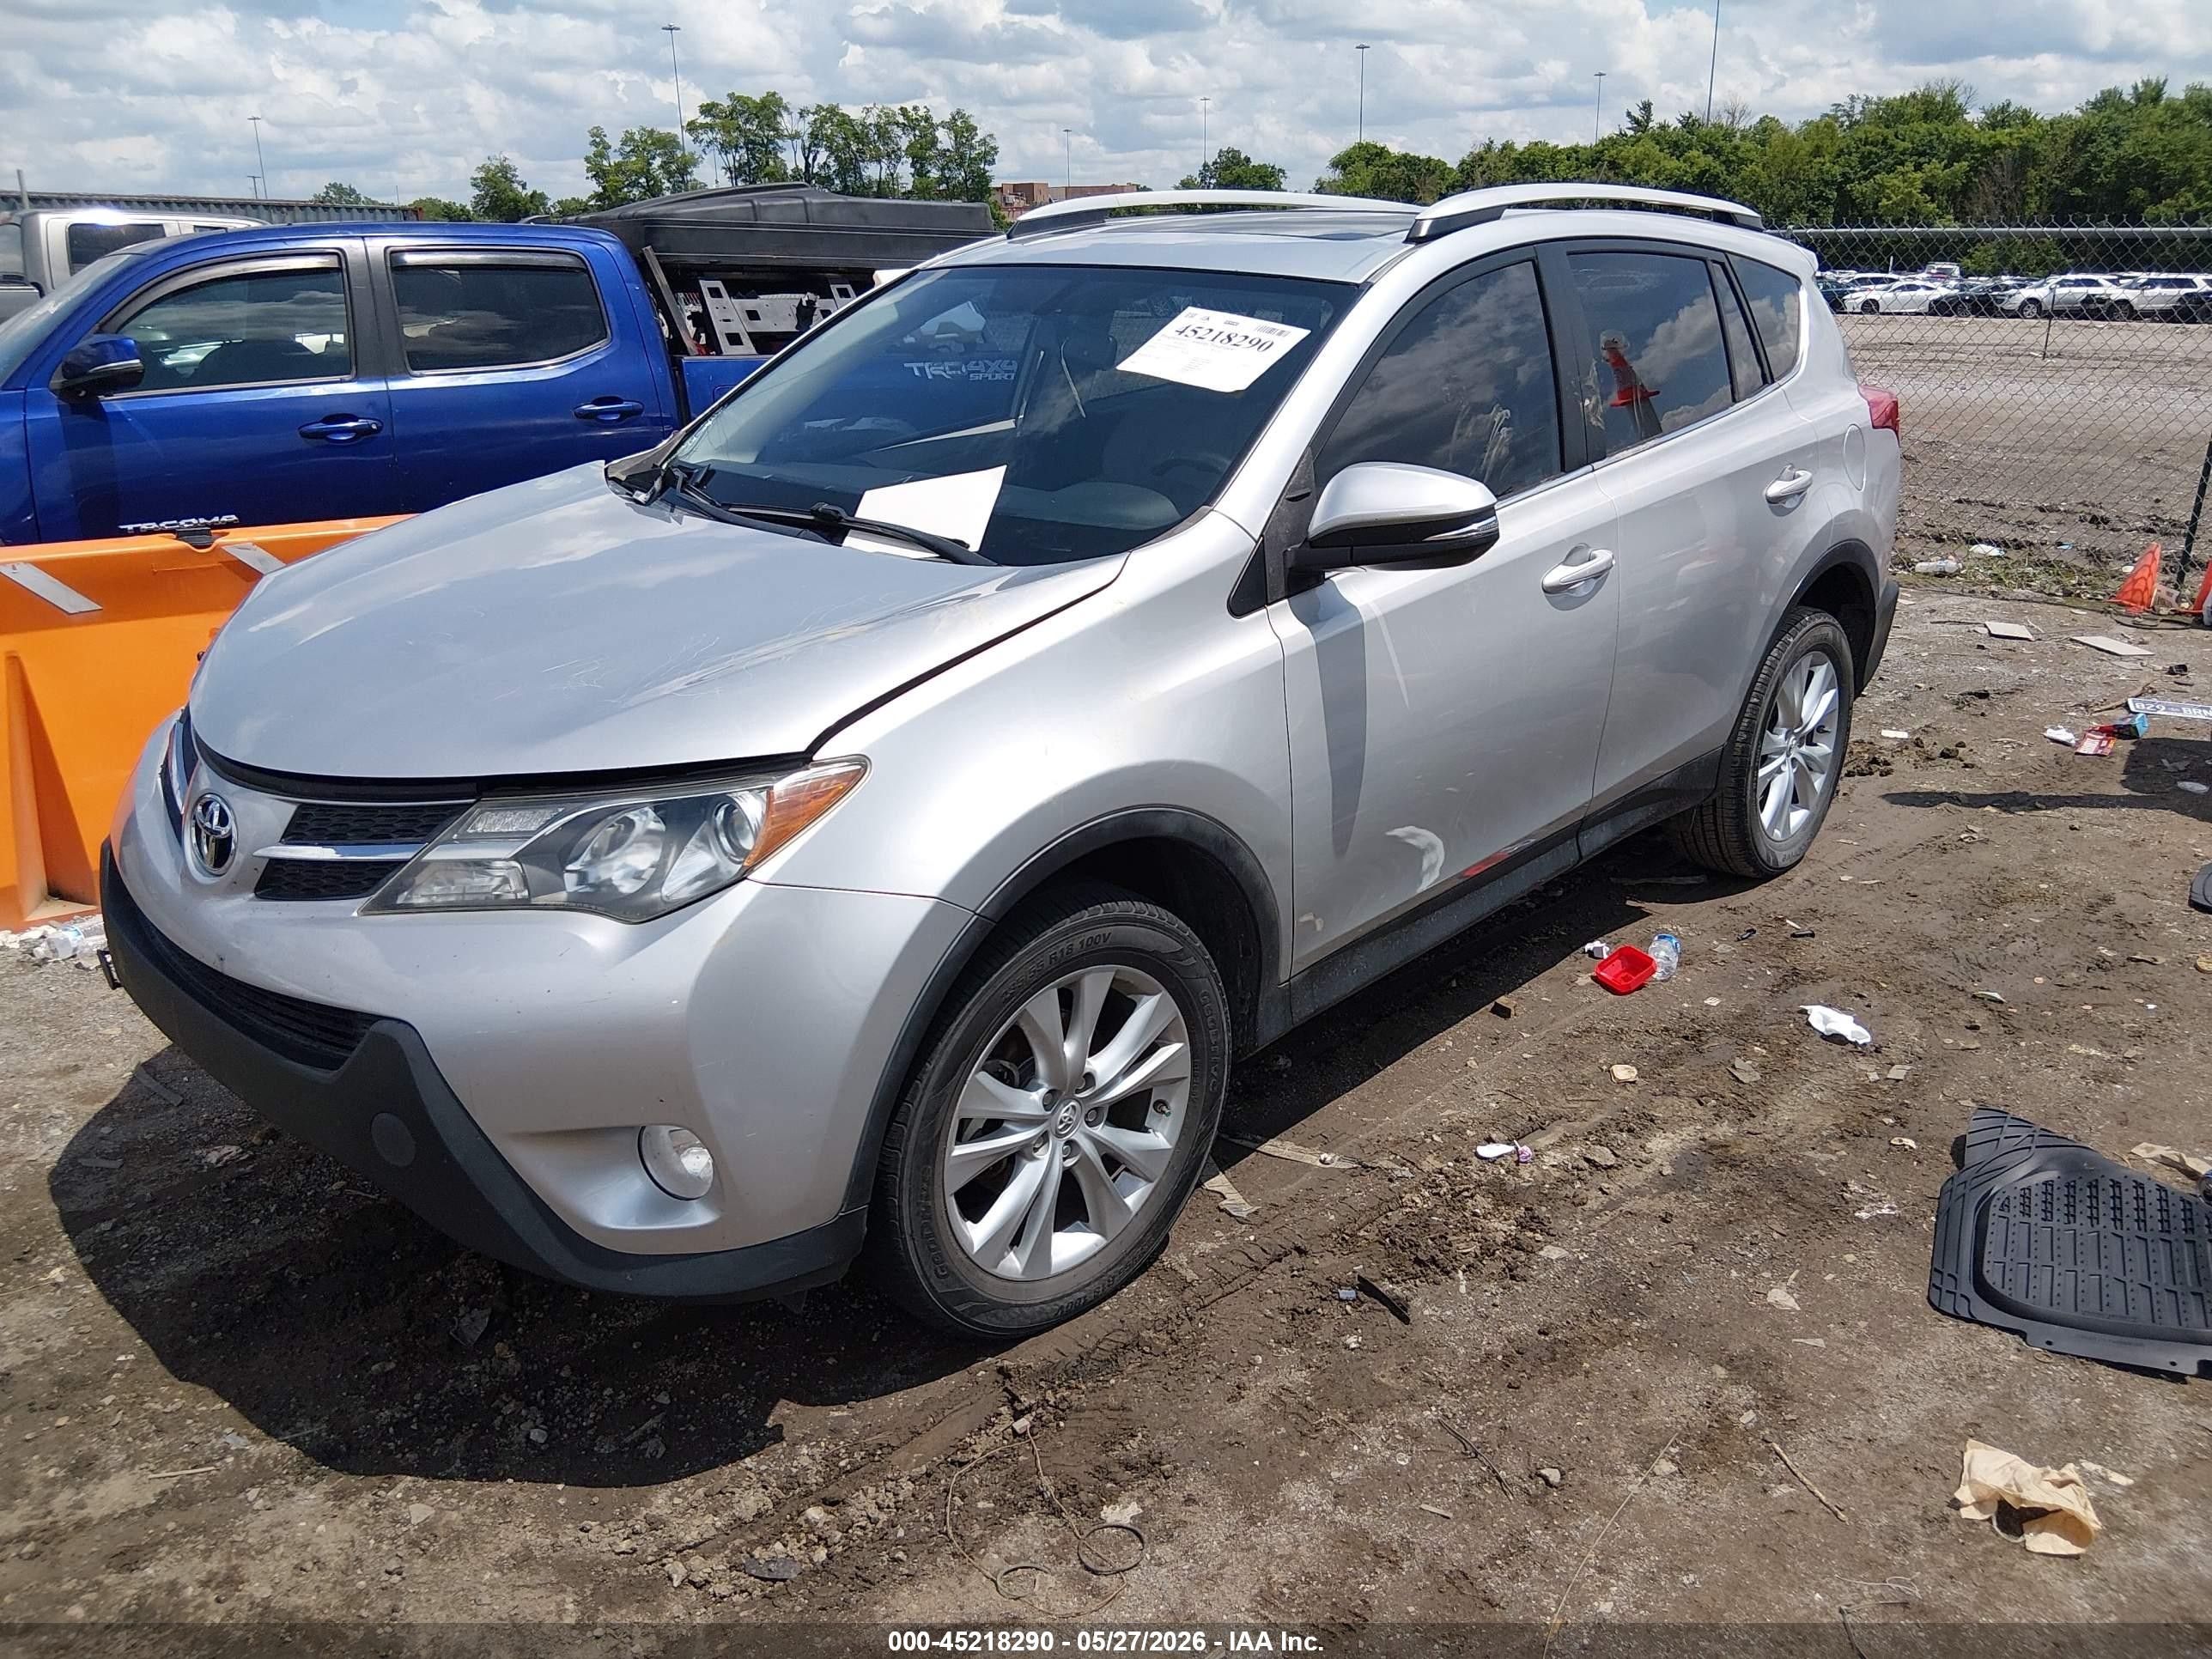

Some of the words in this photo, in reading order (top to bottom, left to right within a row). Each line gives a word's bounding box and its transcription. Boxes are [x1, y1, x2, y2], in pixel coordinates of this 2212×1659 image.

[1175, 324, 1275, 353] 45218290
[118, 514, 240, 533] TACOMA
[2135, 702, 2166, 712] 829
[1048, 943, 1074, 965] R18
[1079, 932, 1112, 950] 100V
